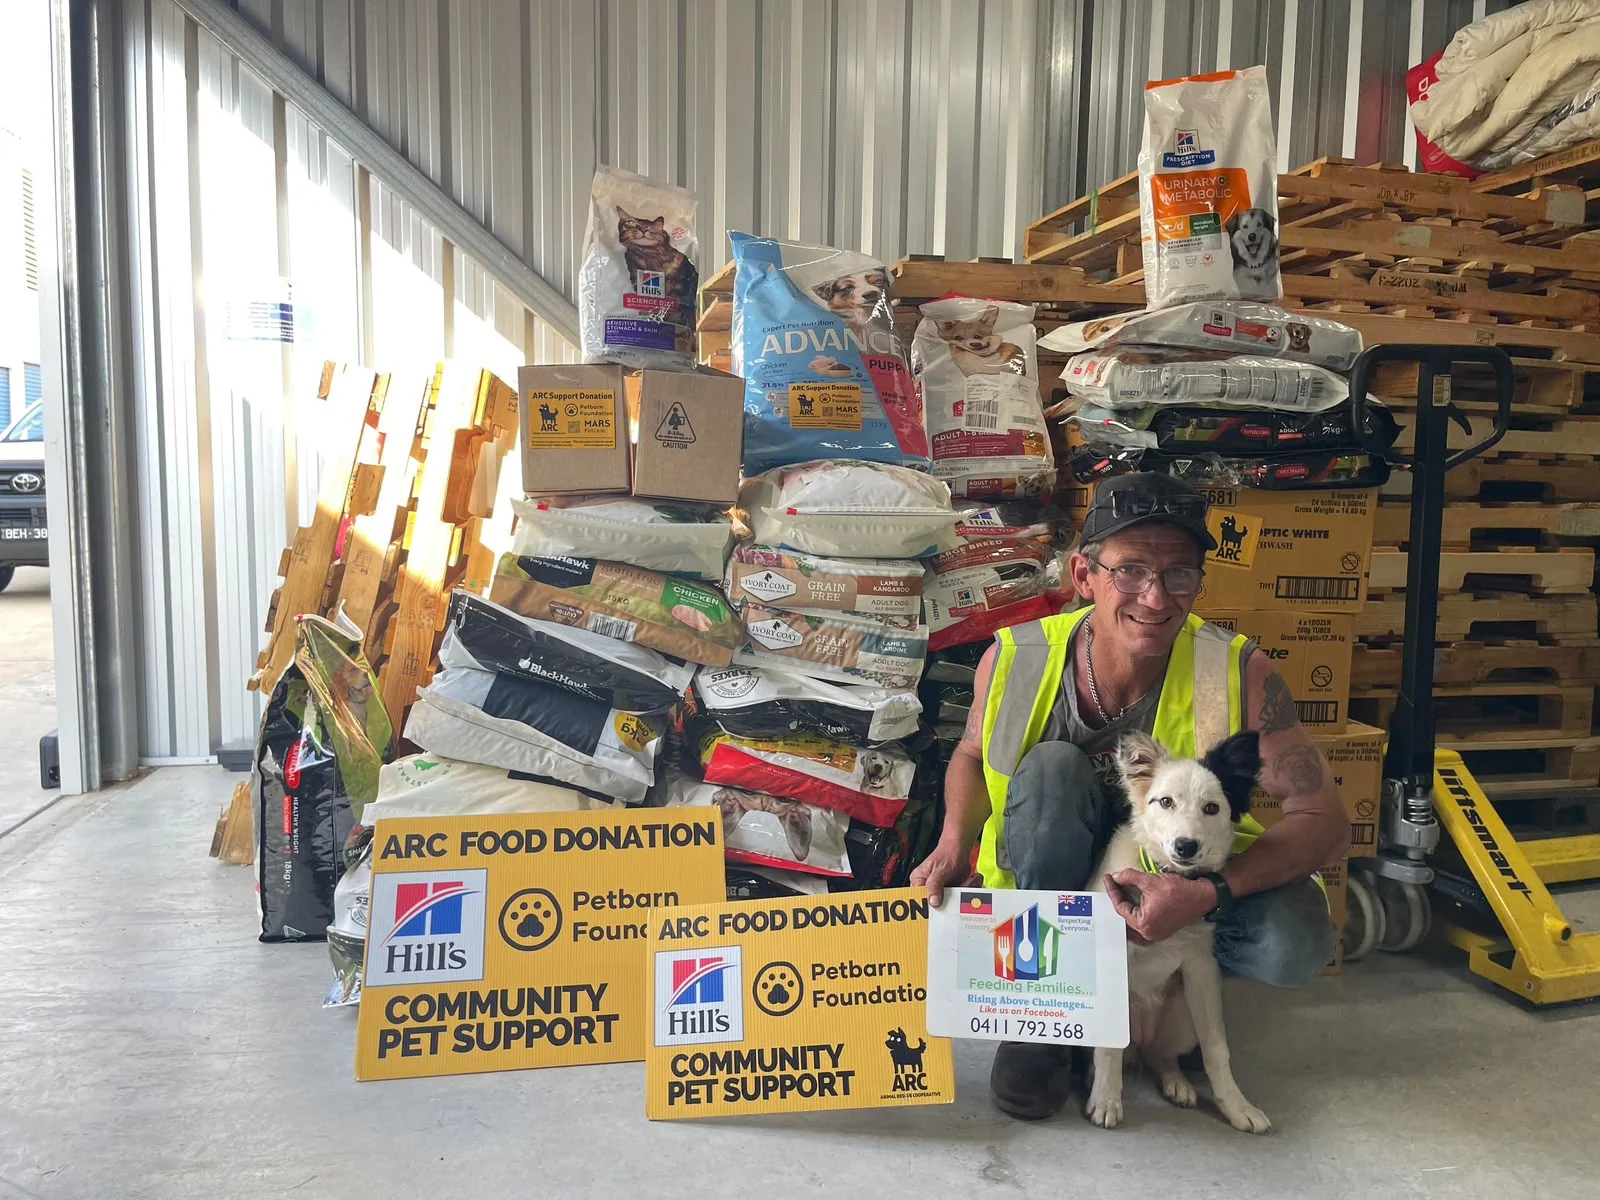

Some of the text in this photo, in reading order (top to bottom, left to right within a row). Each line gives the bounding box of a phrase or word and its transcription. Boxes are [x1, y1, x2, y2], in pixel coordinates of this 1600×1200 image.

[1166, 153, 1211, 163] PRESCRIPTION
[1164, 177, 1217, 190] URINARY
[1165, 188, 1232, 203] METABOLIC
[641, 287, 662, 296] Hill's
[626, 297, 658, 306] SCIENCE
[762, 320, 834, 334] Expert Pet Nutrition
[760, 327, 902, 358] ADVANCE
[760, 362, 788, 371] Chicken
[869, 359, 906, 373] PUPP
[792, 384, 860, 393] ARC Support Donation
[532, 392, 613, 402] ARC Support Donation
[800, 408, 814, 416] ARC
[836, 406, 858, 414] MARS
[540, 424, 558, 432] ARC
[584, 420, 611, 428] MARS
[934, 430, 961, 442] ADULT
[662, 442, 688, 450] CAUTION
[1314, 506, 1334, 515] Weight
[6, 528, 28, 539] BEH
[1292, 529, 1330, 540] WHITE
[968, 539, 1004, 551] BREED
[1216, 547, 1242, 562] ARC
[600, 562, 632, 580] grain
[634, 570, 661, 586] free
[745, 579, 768, 588] IVORY
[768, 582, 792, 590] COAT
[808, 580, 846, 592] GRAIN
[873, 585, 910, 593] KANGAROO
[1259, 582, 1274, 590] TH11
[607, 594, 630, 606] 15KG
[672, 584, 720, 606] CHICKEN
[810, 590, 841, 602] FREE
[871, 599, 894, 607] ADULT
[752, 626, 776, 636] IVORY
[776, 631, 798, 642] COAT
[814, 634, 850, 648] GRAIN
[882, 640, 900, 648] LAMB
[816, 645, 844, 657] FREE
[872, 658, 910, 668] ADULT DOG
[292, 796, 300, 854] HEALTHY WEIGHT
[380, 833, 448, 860] ARC
[460, 828, 548, 856] FOOD
[553, 821, 716, 852] DONATION
[282, 860, 292, 880] 18kg
[573, 889, 680, 911] Petbarn
[658, 898, 930, 941] ARC FOOD DONATION
[960, 915, 989, 923] Welcome
[1058, 917, 1092, 926] Respecting
[573, 921, 648, 943] Foun
[385, 941, 467, 974] Hill's
[812, 960, 900, 982] Petbarn
[969, 978, 1093, 996] Feeding Families...
[812, 984, 928, 1008] Foundatio
[968, 994, 1094, 1011] Rising Above Challenges...
[384, 982, 609, 1025] COMMUNITY
[980, 1004, 997, 1014] Like
[1010, 1008, 1022, 1016] on
[1024, 1008, 1068, 1018] Facebook.
[668, 1009, 730, 1036] Hill's
[970, 1017, 1084, 1040] 0411 792 568
[378, 1013, 620, 1060] PET SUPPORT
[670, 1043, 844, 1078] COMMUNITY
[668, 1070, 856, 1106] PET SUPPORT
[892, 1072, 928, 1092] ARC
